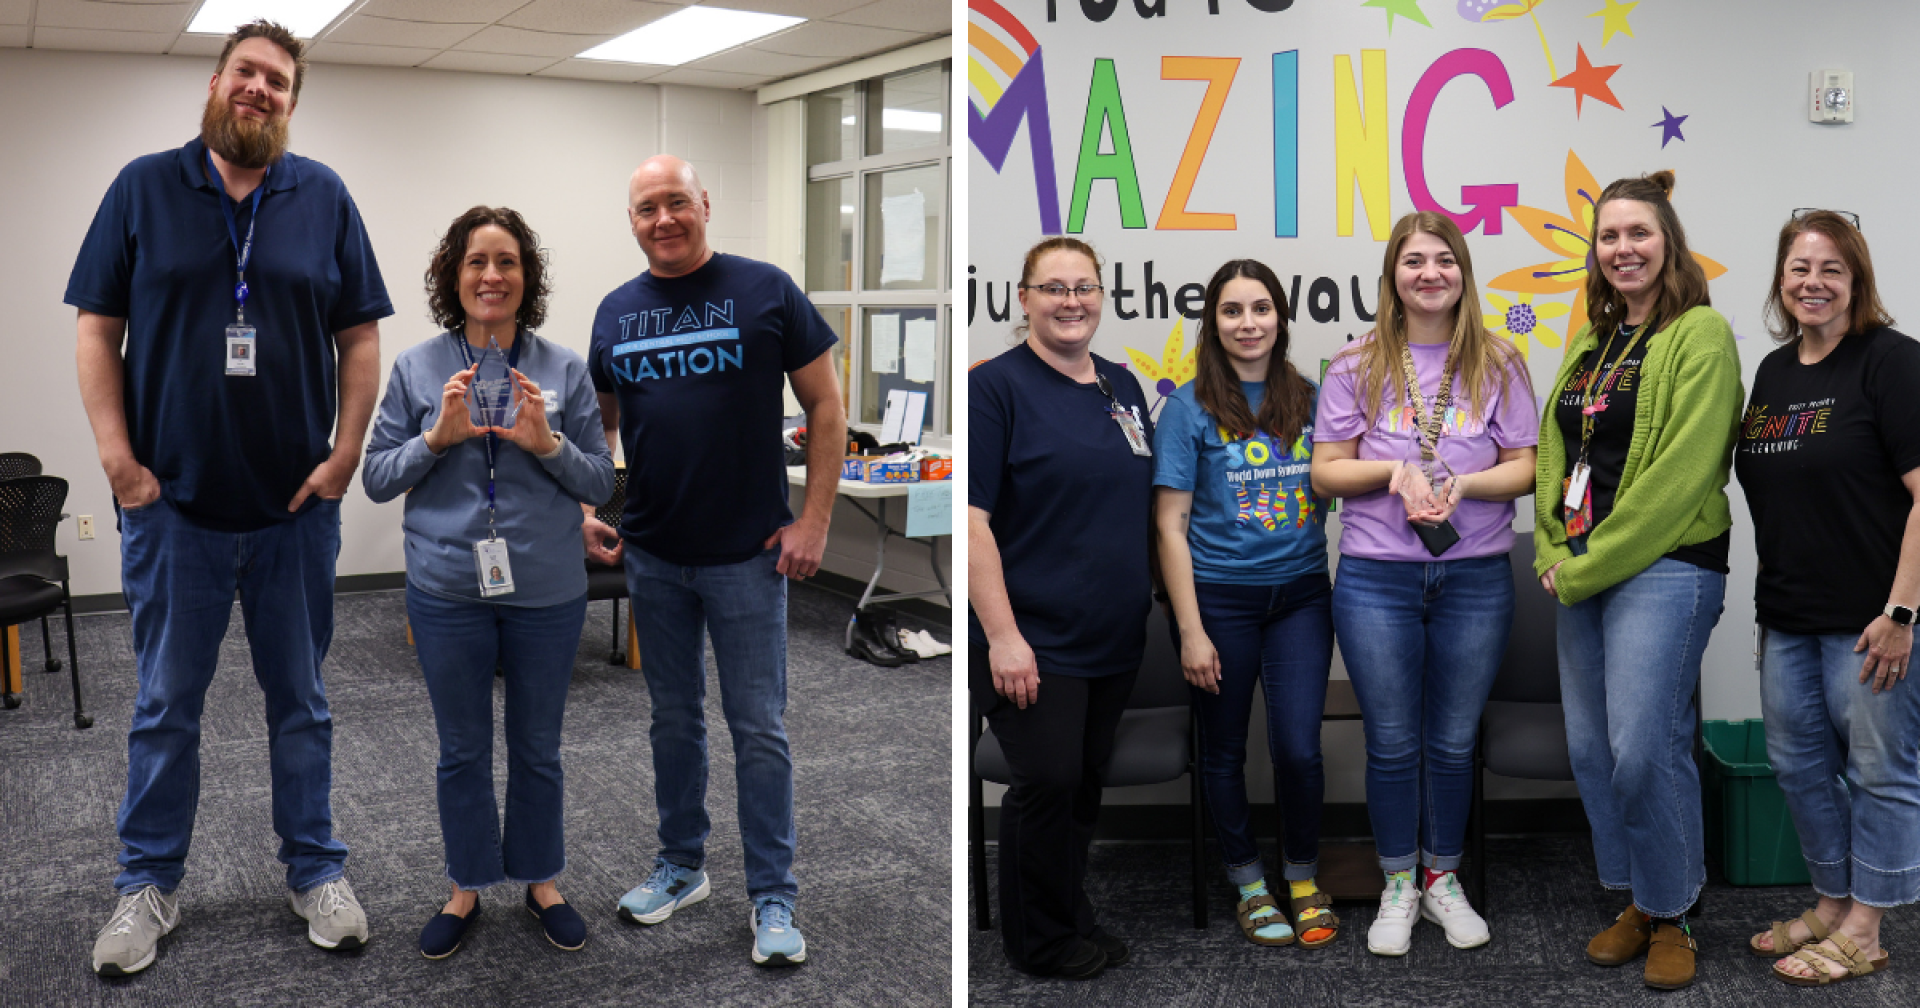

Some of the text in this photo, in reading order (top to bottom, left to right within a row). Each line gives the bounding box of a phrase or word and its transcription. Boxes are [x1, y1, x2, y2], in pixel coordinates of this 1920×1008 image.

[1111, 260, 1207, 321] the
[619, 299, 733, 340] TITAN
[611, 344, 743, 385] NATION
[1225, 434, 1314, 469] SOCK
[1226, 469, 1252, 483] World
[1253, 468, 1276, 480] Down
